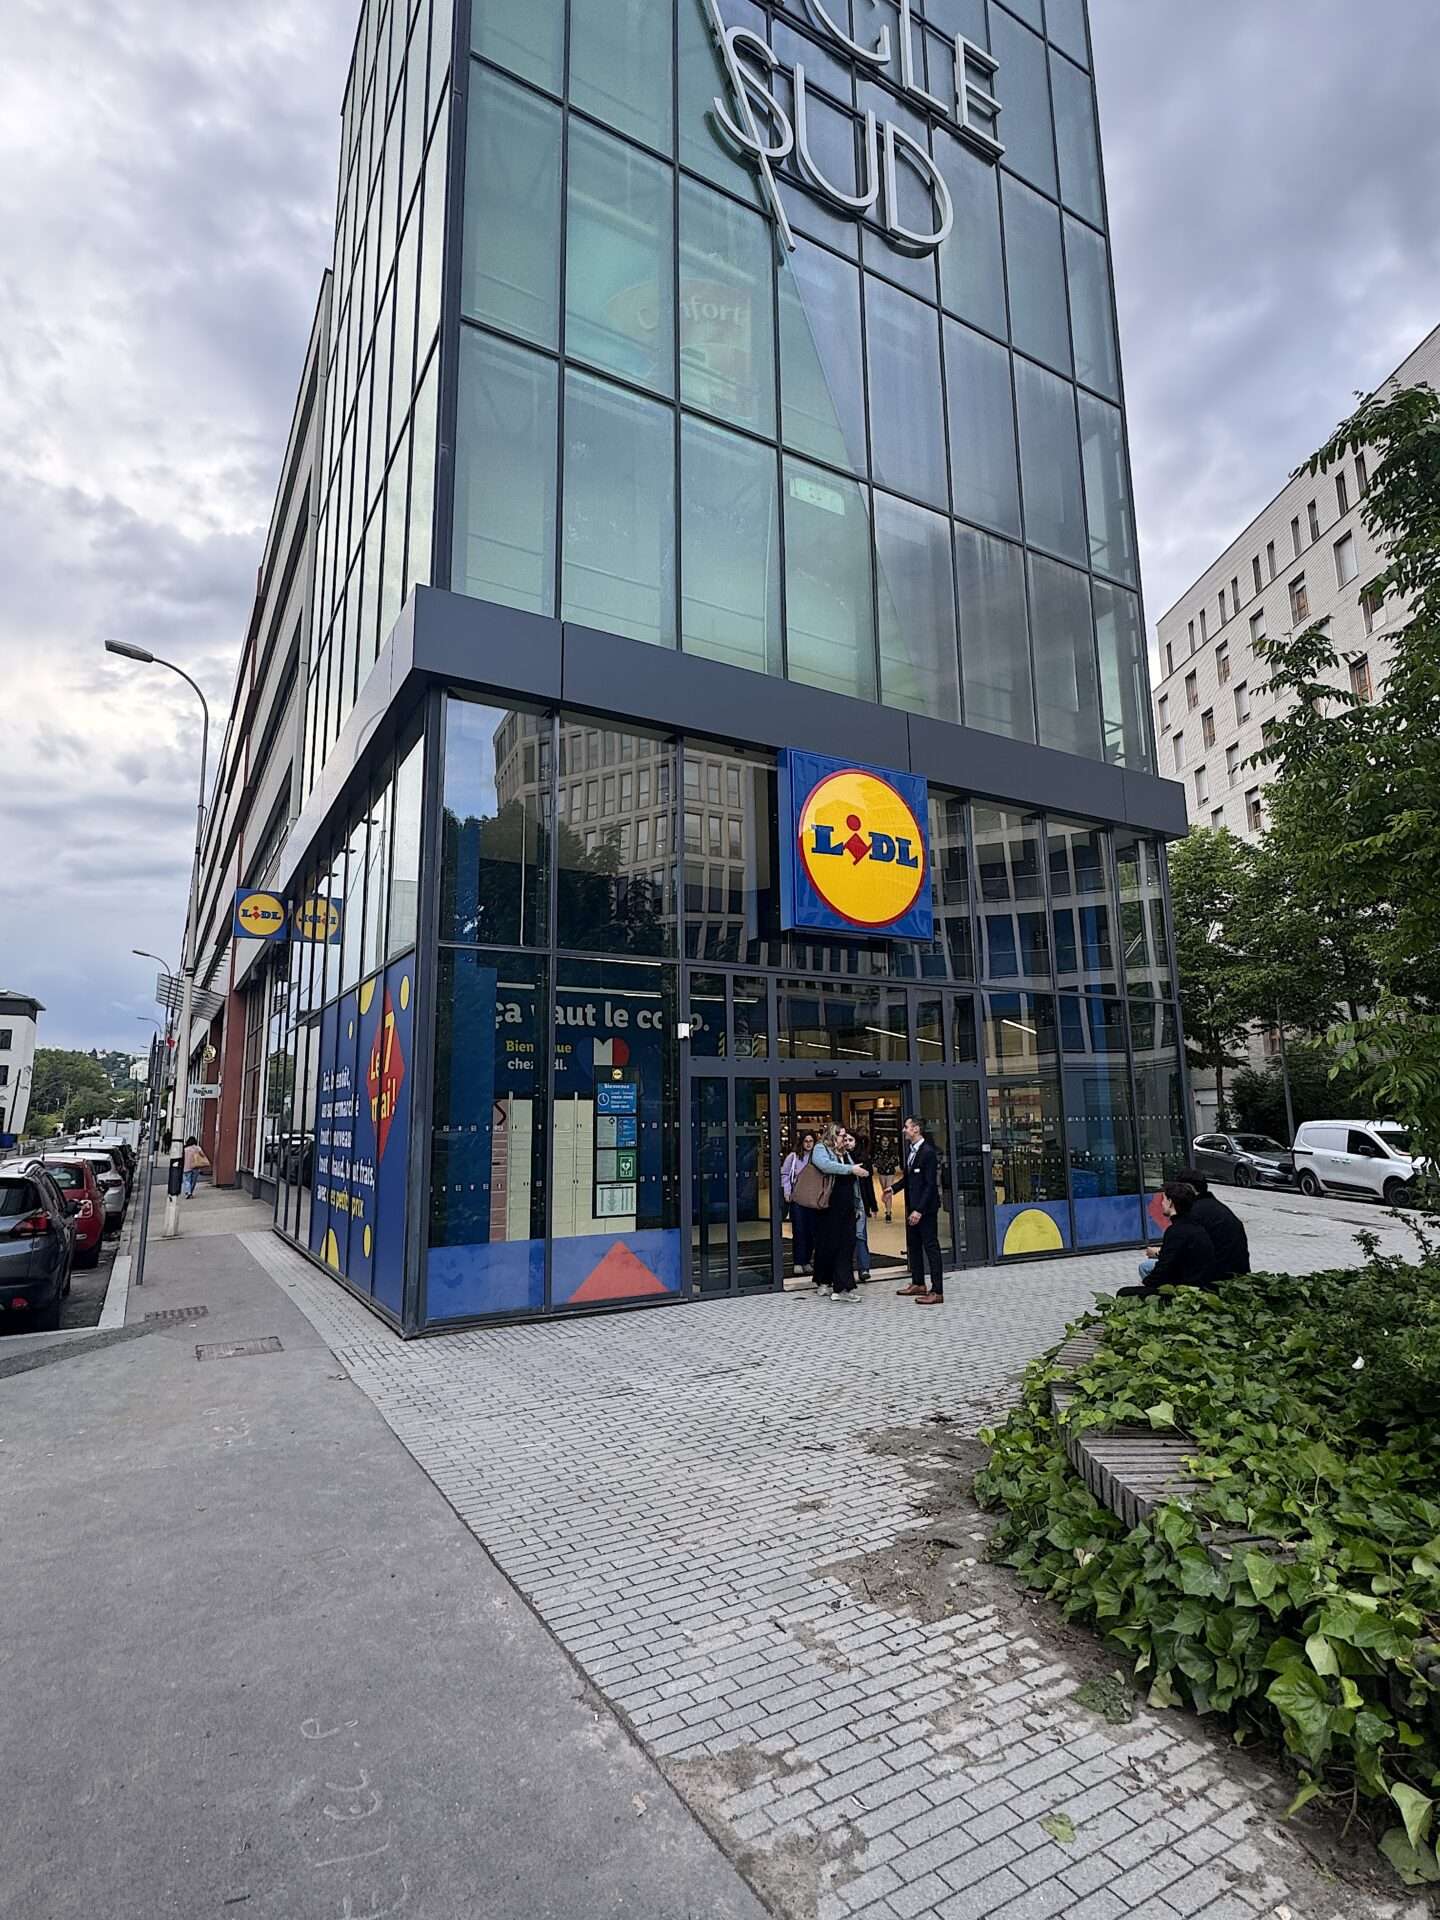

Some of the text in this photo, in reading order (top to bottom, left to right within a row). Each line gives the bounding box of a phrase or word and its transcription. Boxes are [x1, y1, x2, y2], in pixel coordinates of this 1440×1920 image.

[714, 26, 954, 256] SUD
[530, 1003, 596, 1027] aut
[604, 1001, 629, 1028] le
[636, 1008, 711, 1038] cop.
[383, 1009, 395, 1074] 7
[505, 1039, 573, 1054] Bienue
[329, 1129, 352, 1149] ouveau
